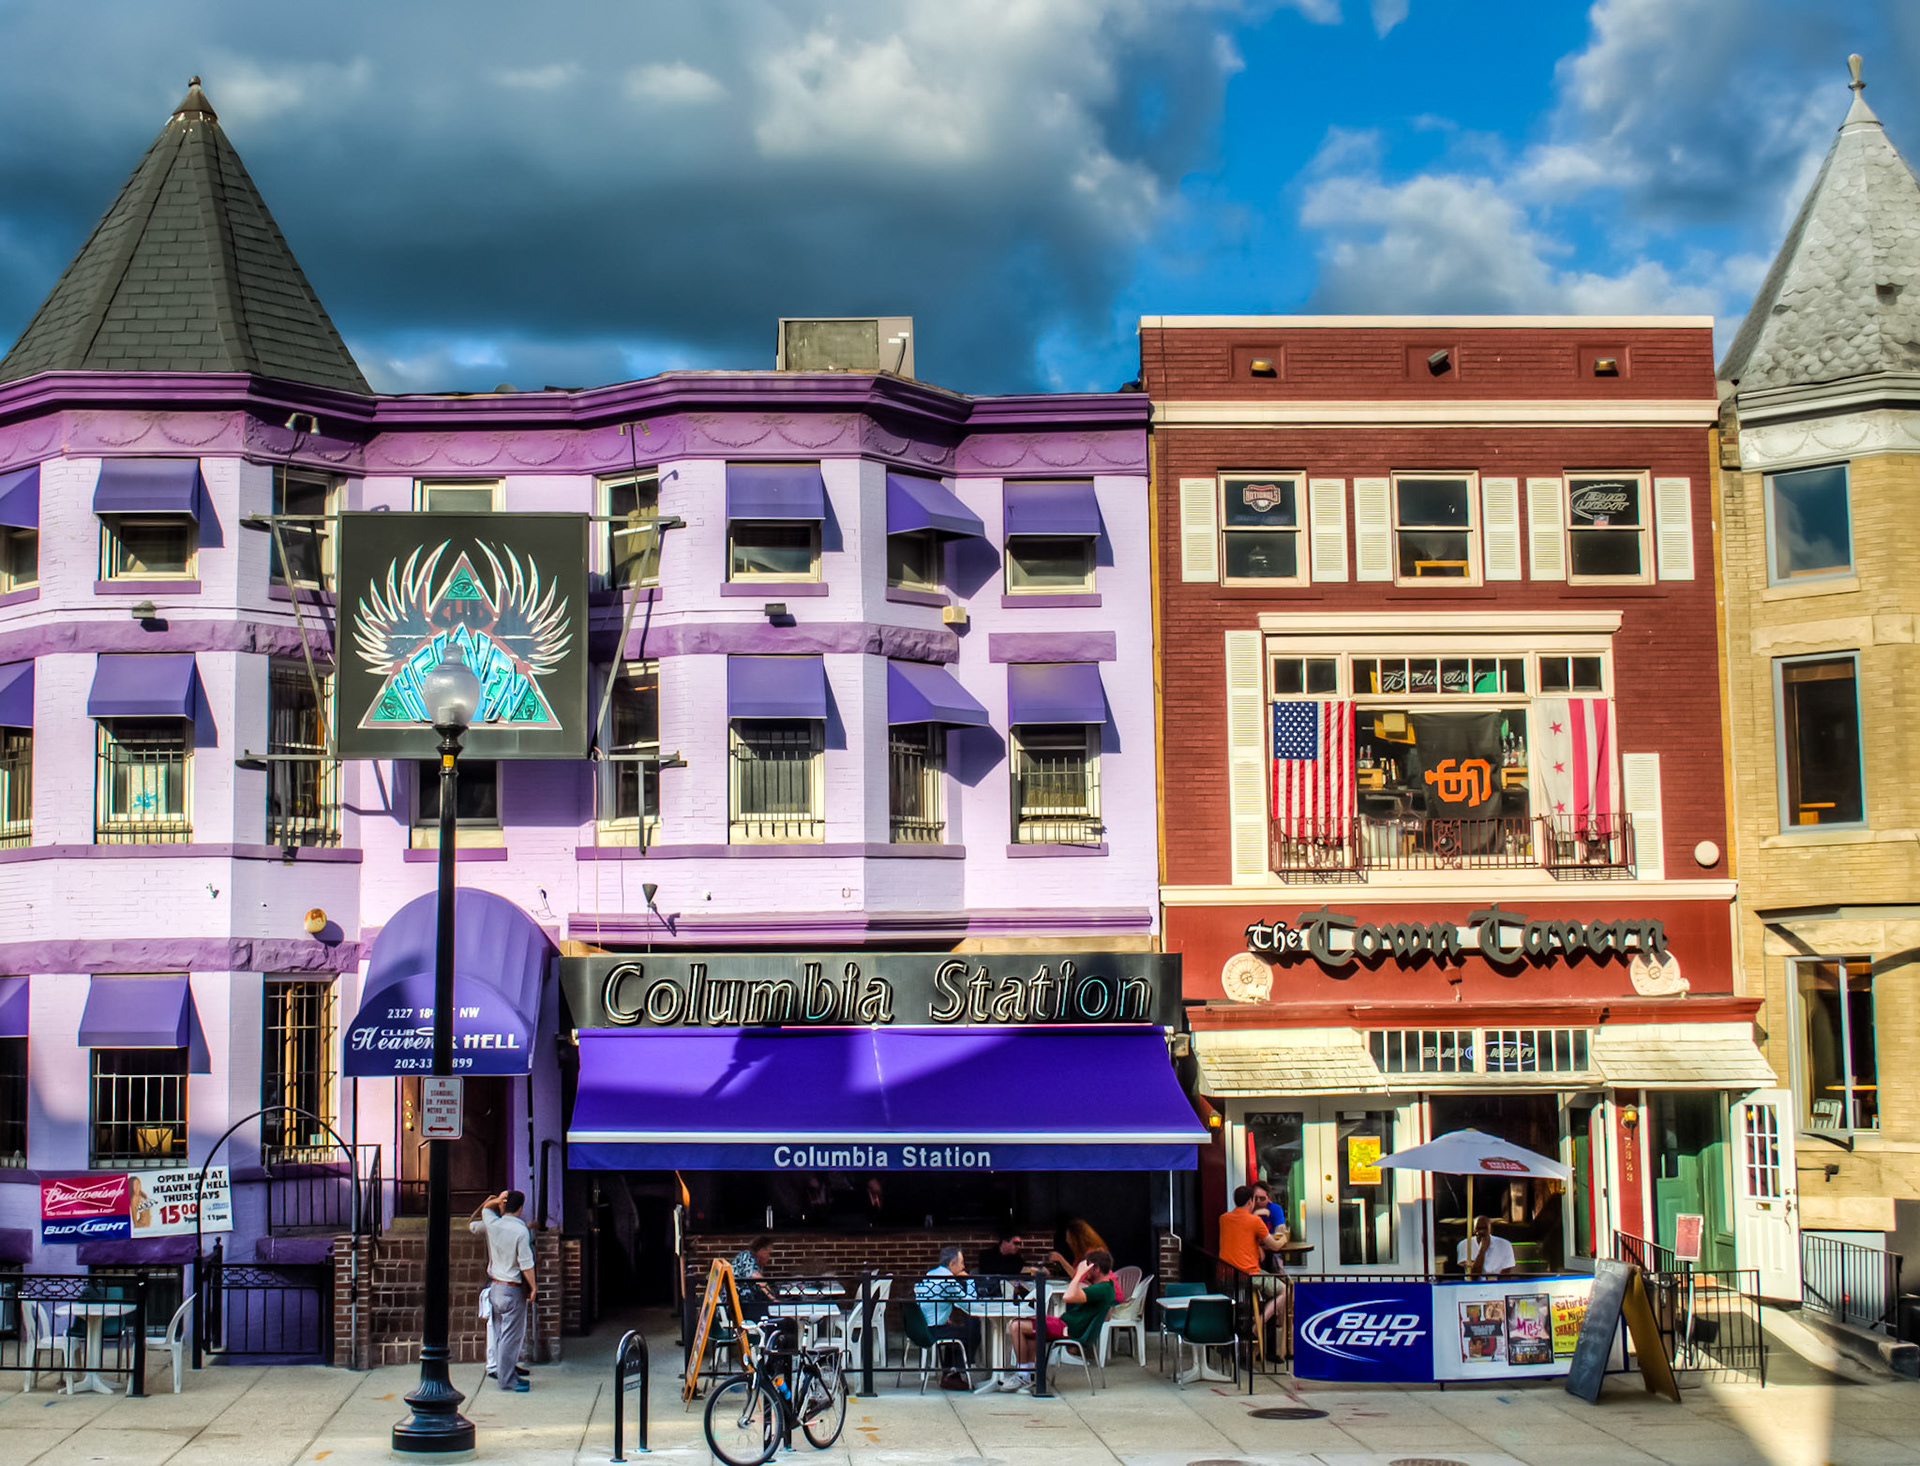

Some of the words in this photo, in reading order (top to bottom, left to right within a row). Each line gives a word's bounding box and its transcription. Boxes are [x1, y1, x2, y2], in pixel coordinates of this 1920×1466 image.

[1584, 491, 1627, 501] BUD
[1575, 500, 1630, 511] LIGHT
[1247, 917, 1300, 953] The
[1296, 904, 1463, 966] Town
[1466, 903, 1669, 965] Tavern
[601, 961, 895, 1027] Columbia
[929, 959, 1153, 1022] Station
[387, 1008, 413, 1019] 2327
[459, 1007, 480, 1018] NW
[352, 1027, 435, 1050] Heaven
[463, 1033, 520, 1049] HELL
[1422, 1046, 1464, 1058] BUD
[1250, 1114, 1296, 1125] ATM
[774, 1146, 888, 1168] Columbia
[902, 1146, 991, 1168] Station
[157, 1173, 184, 1183] OPEN
[211, 1170, 223, 1179] AT
[153, 1183, 191, 1194] HEAVEN
[206, 1180, 228, 1189] HELL
[43, 1186, 125, 1203] Budweiser
[44, 1225, 77, 1235] BUD
[82, 1221, 128, 1232] LIGHT
[1336, 1312, 1420, 1330] BUD
[1317, 1328, 1427, 1346] LIGHT
